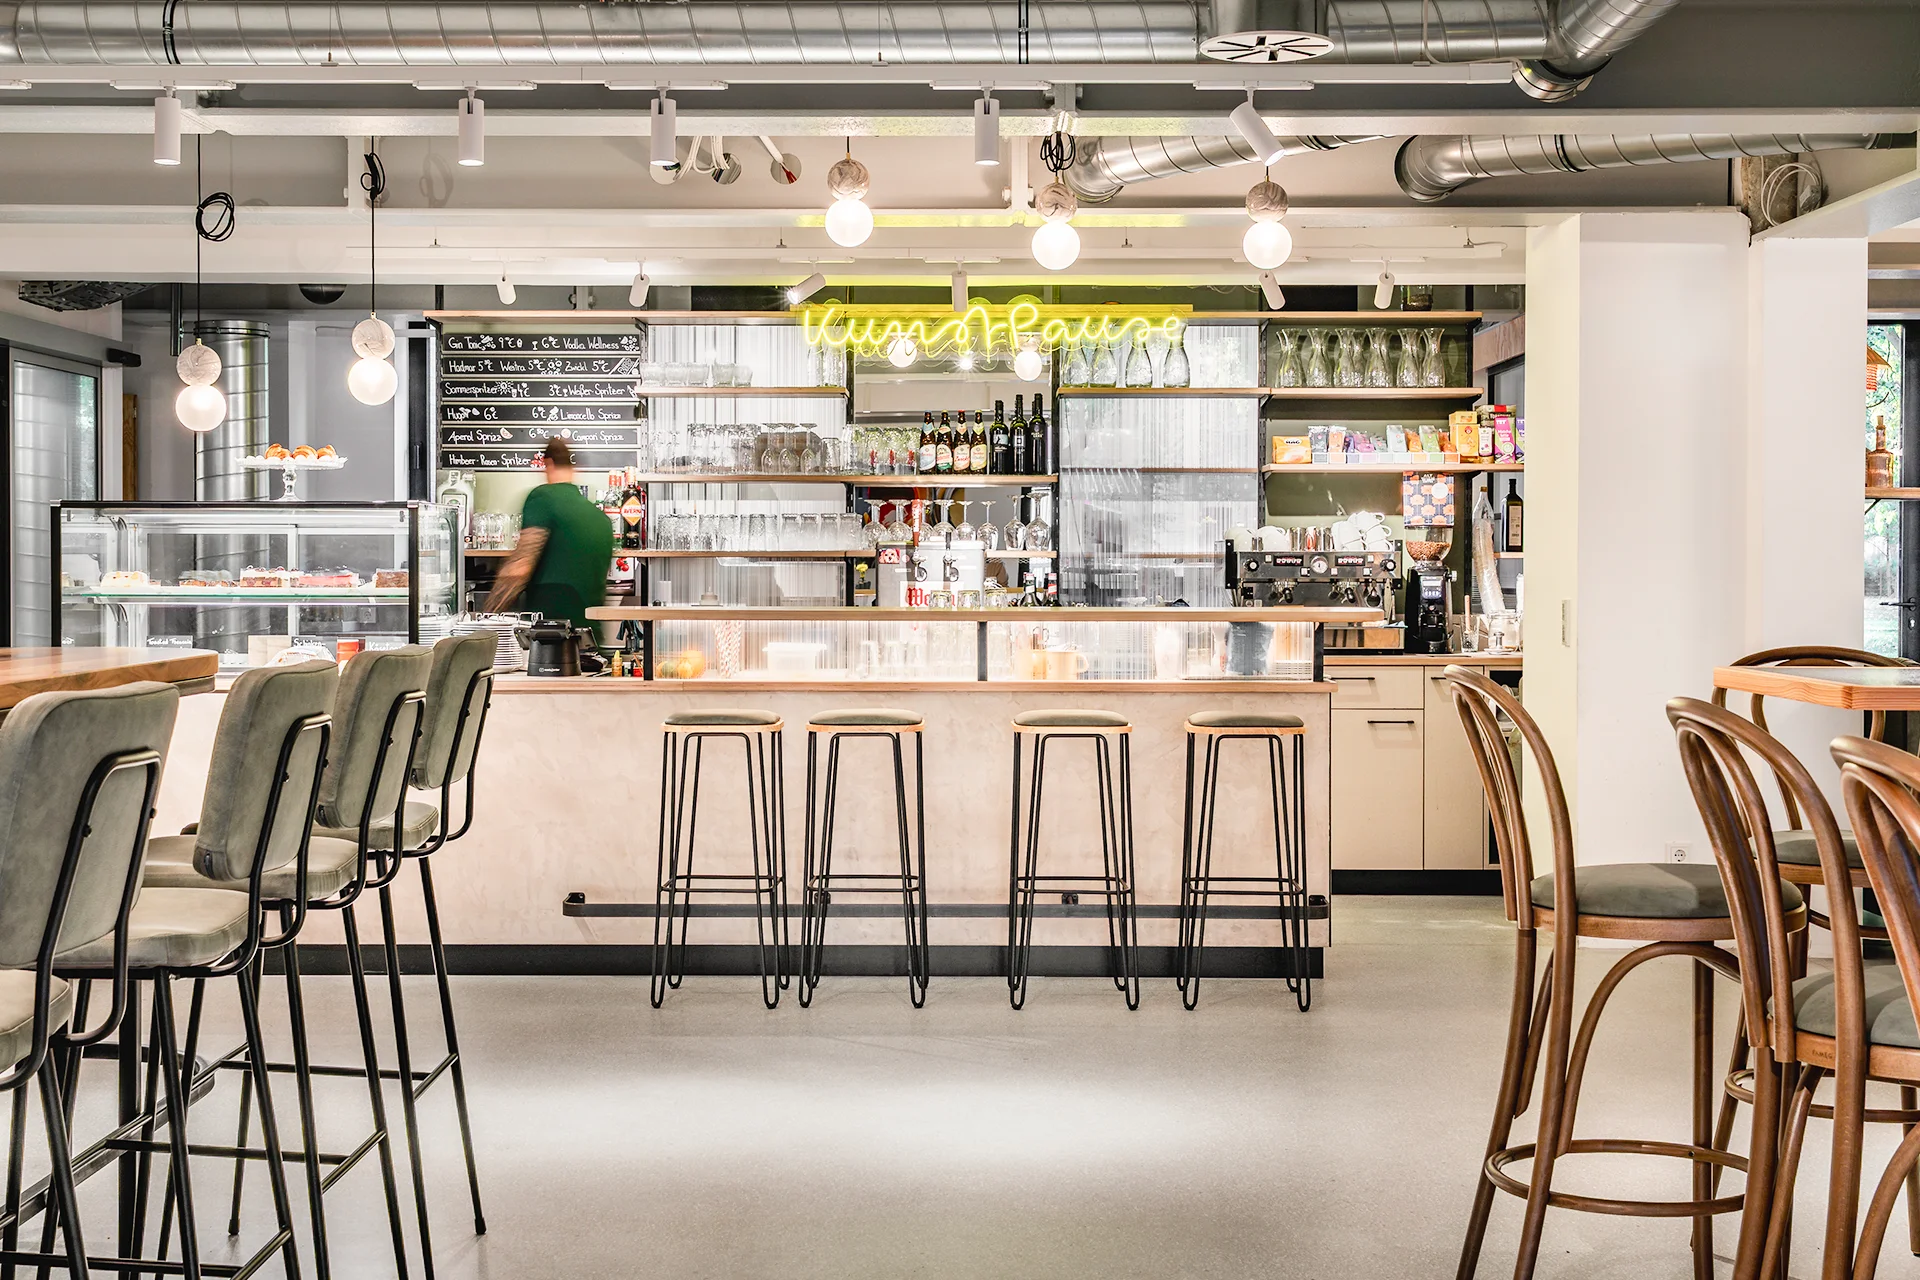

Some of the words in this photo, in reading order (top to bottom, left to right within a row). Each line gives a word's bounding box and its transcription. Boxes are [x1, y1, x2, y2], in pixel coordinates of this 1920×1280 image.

[448, 337, 464, 349] Gin
[464, 336, 482, 349] Tonic
[563, 337, 586, 349] Vodka
[587, 336, 620, 349] Wellness
[444, 382, 497, 398] Sommerspritzer
[595, 382, 626, 398] Spritzer
[560, 407, 595, 420] Limoncello
[447, 430, 474, 444] Aperol
[571, 430, 598, 444] Campari
[501, 452, 532, 468] Spritzer
